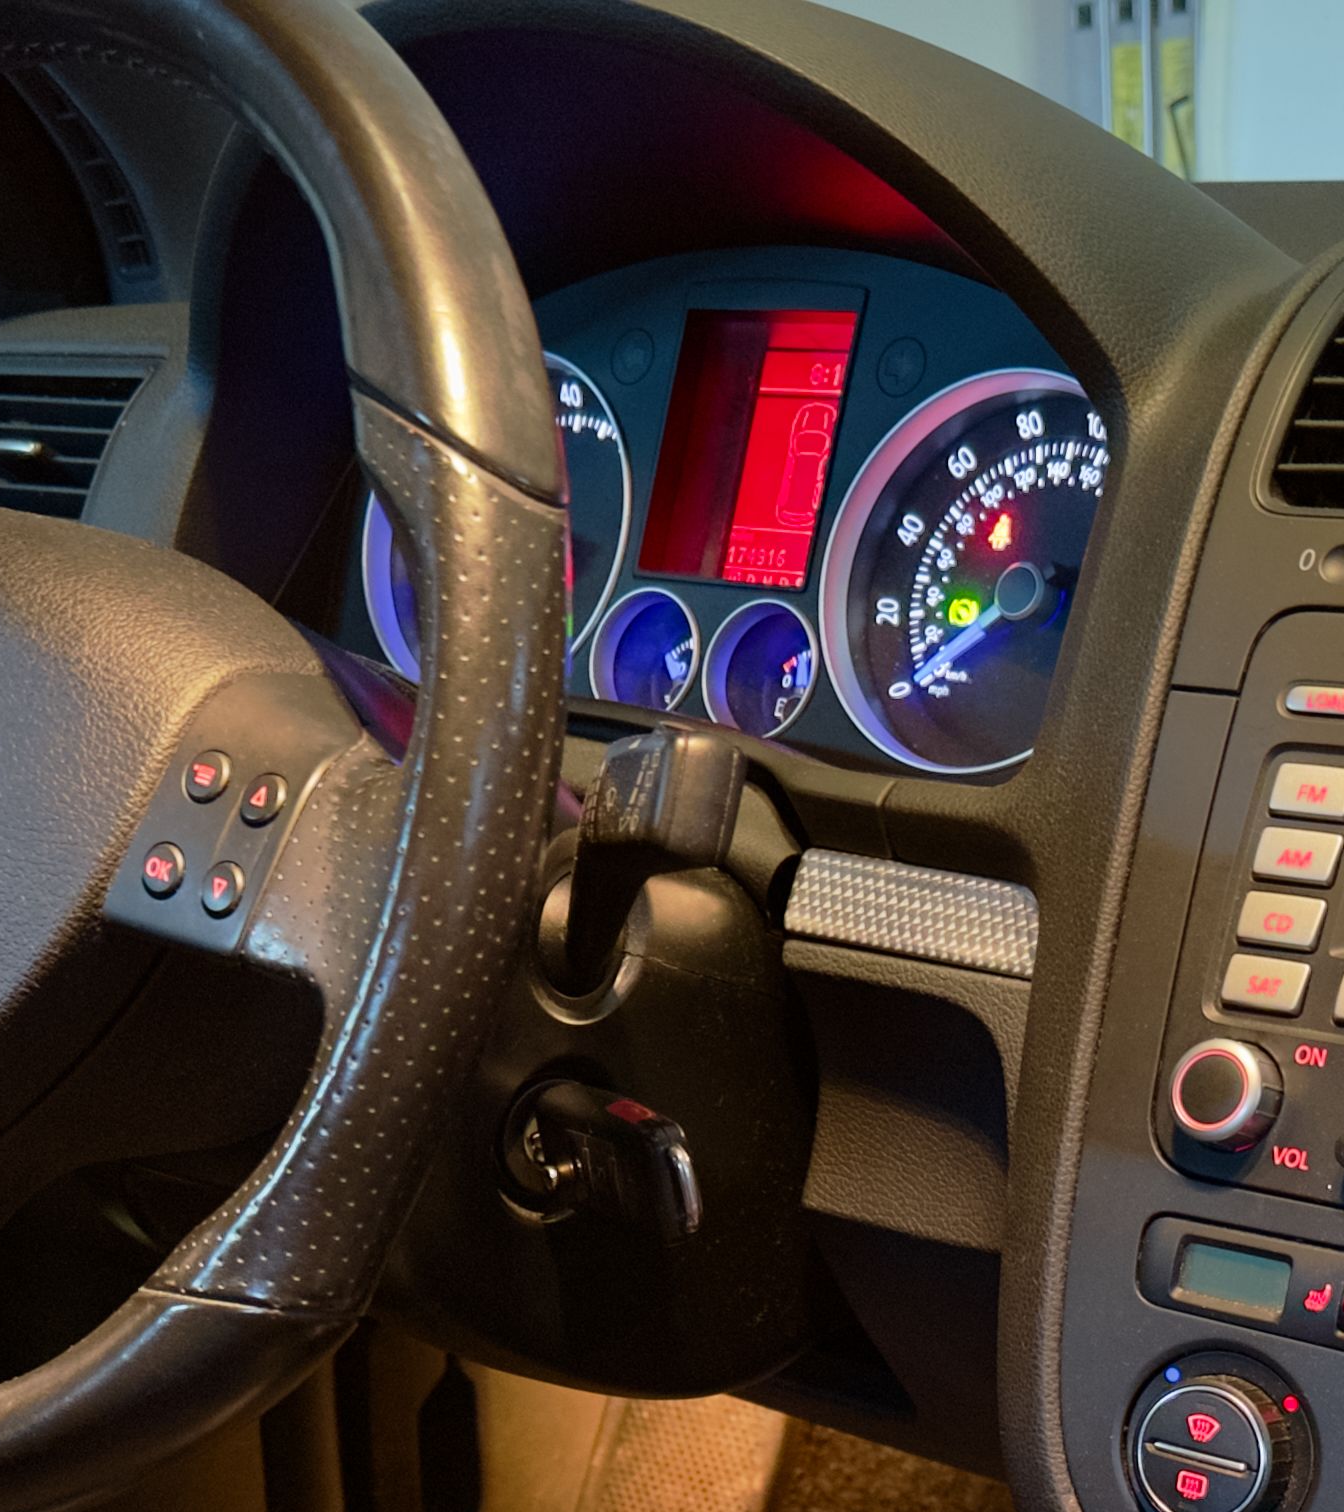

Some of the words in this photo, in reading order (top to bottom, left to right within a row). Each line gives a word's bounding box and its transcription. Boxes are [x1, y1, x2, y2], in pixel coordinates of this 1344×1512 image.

[559, 383, 583, 408] 40
[1016, 411, 1044, 440] 80
[947, 446, 977, 479] 60
[1046, 460, 1070, 483] 140
[1012, 466, 1037, 489] 120
[1078, 464, 1102, 487] 160
[980, 483, 1004, 508] 100
[896, 512, 926, 549] 40
[955, 514, 974, 536] 80
[936, 549, 953, 570] 60
[925, 586, 941, 607] 40
[875, 597, 900, 627] 20
[924, 624, 940, 645] 20
[888, 681, 910, 700] 0
[1297, 783, 1328, 803] FM
[144, 856, 173, 881] OK
[1276, 848, 1313, 869] AM
[1263, 912, 1293, 934] CD
[1247, 975, 1282, 996] SAT
[1294, 1044, 1328, 1068] ON
[1273, 1147, 1307, 1169] VOL
